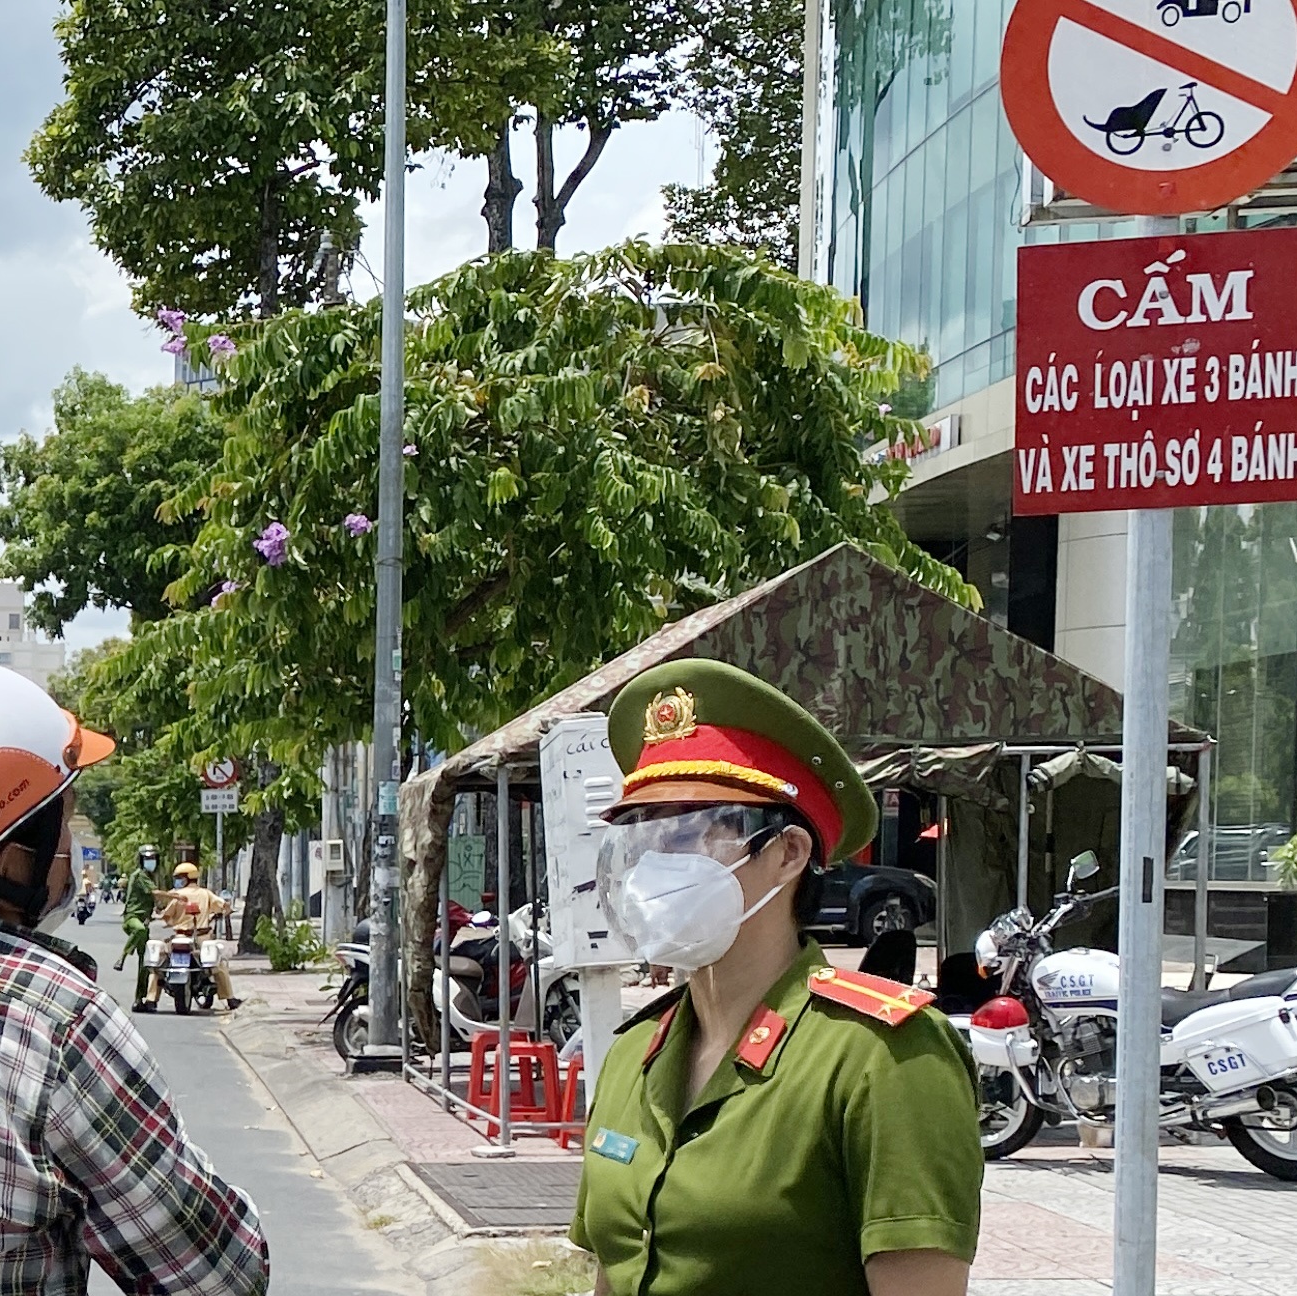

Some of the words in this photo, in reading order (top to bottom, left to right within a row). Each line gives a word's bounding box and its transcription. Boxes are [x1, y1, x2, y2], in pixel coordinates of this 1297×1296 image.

[1077, 249, 1254, 330] CẤM
[1025, 352, 1079, 414] CÁC
[1161, 356, 1197, 405] XE
[1204, 355, 1220, 403] 3
[1228, 338, 1297, 401] BÁNH
[1018, 433, 1054, 494] VÀ
[1060, 444, 1096, 492] XE
[1103, 430, 1157, 489] THÔ
[1165, 428, 1200, 487] SƠ
[1207, 437, 1223, 484] 4
[1230, 420, 1297, 483] BÁNH
[1207, 1053, 1246, 1075] CSGT
